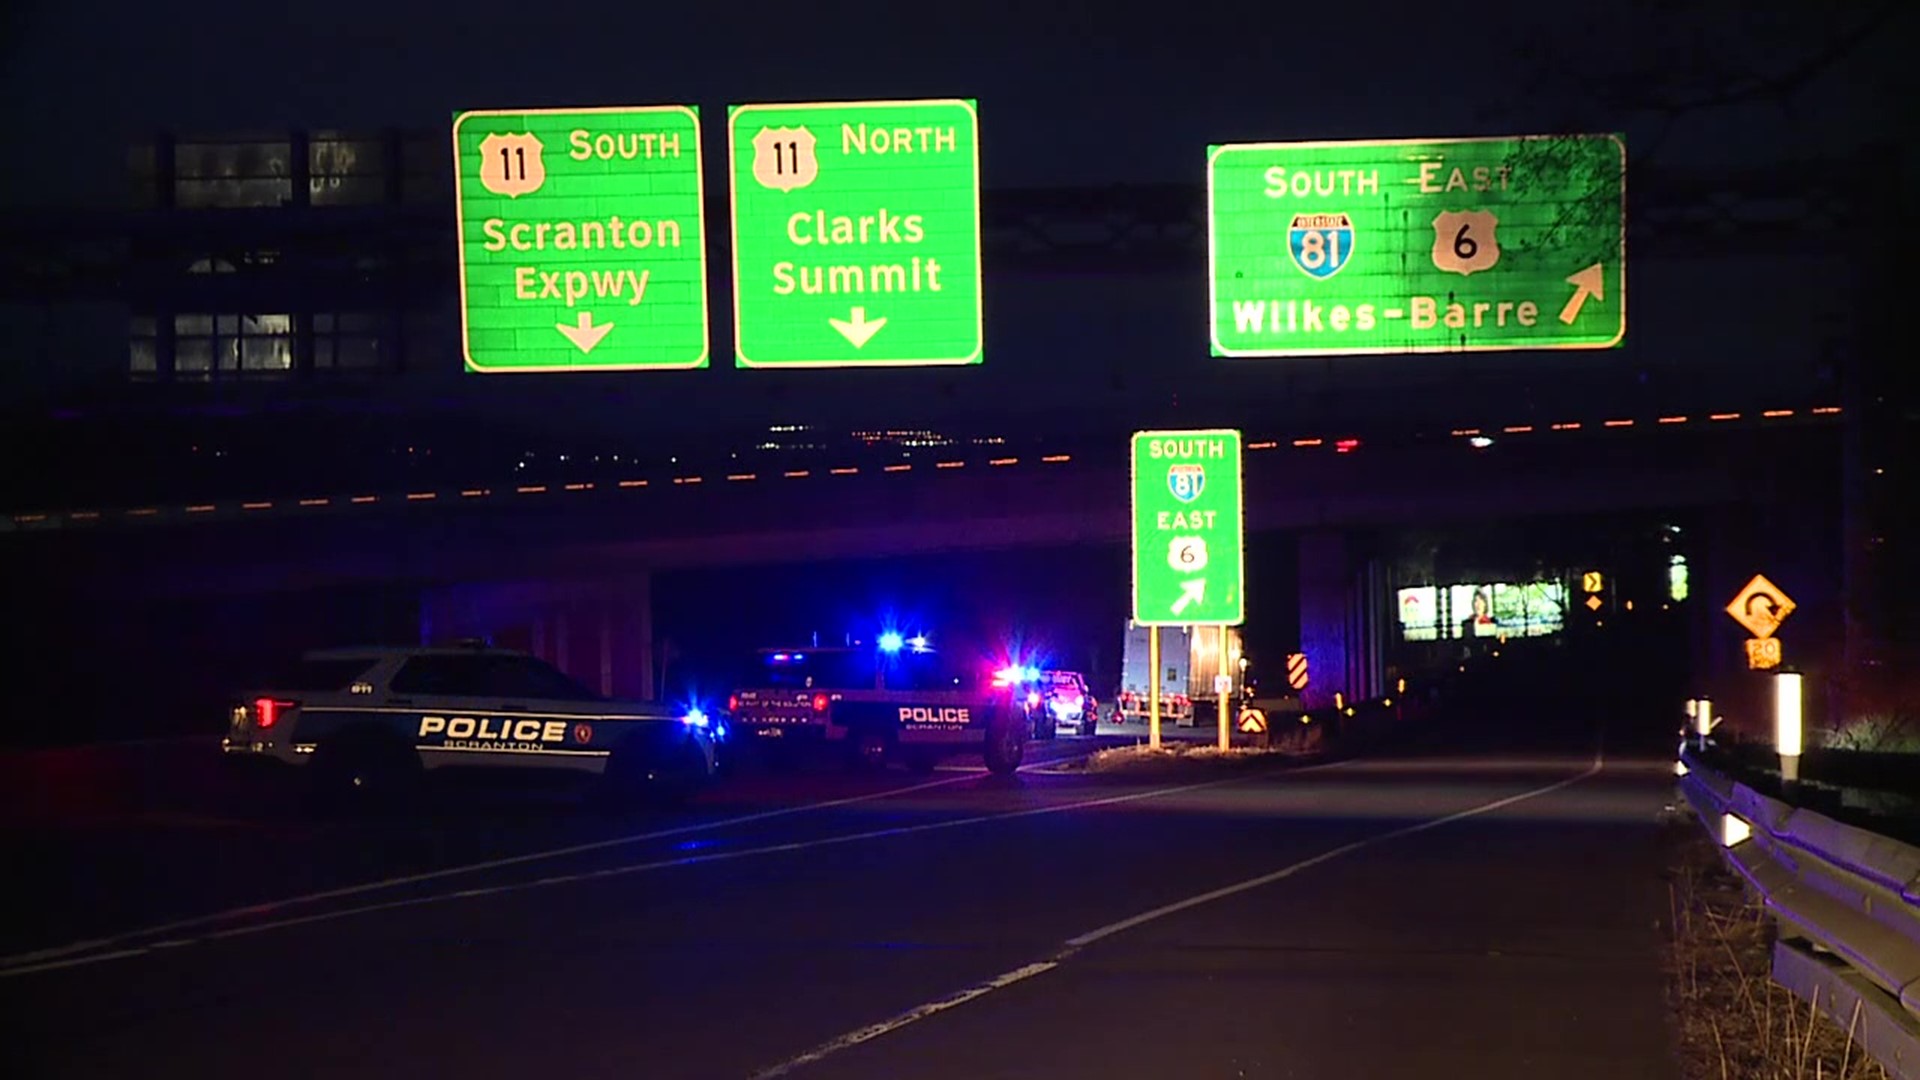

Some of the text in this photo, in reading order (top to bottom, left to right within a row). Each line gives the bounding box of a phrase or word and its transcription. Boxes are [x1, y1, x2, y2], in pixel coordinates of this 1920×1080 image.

[569, 130, 681, 161] SOUTH
[841, 123, 956, 155] NORTH
[499, 147, 526, 181] 11
[773, 141, 799, 175] 11
[1264, 166, 1380, 198] SOUTH
[1418, 162, 1512, 194] EAST
[482, 215, 682, 252] Scranton
[786, 208, 925, 246] Clarks
[1453, 224, 1478, 260] 6
[1300, 230, 1340, 269] 81
[514, 266, 651, 307] Expwy
[772, 257, 943, 295] Summit
[1149, 440, 1224, 459] SOUTH
[1177, 473, 1198, 496] 81
[1157, 511, 1217, 530] EAST
[1180, 545, 1195, 564] 6
[417, 715, 568, 743] POLICE
[898, 706, 971, 724] POLICE
[443, 739, 544, 751] SCRANTON
